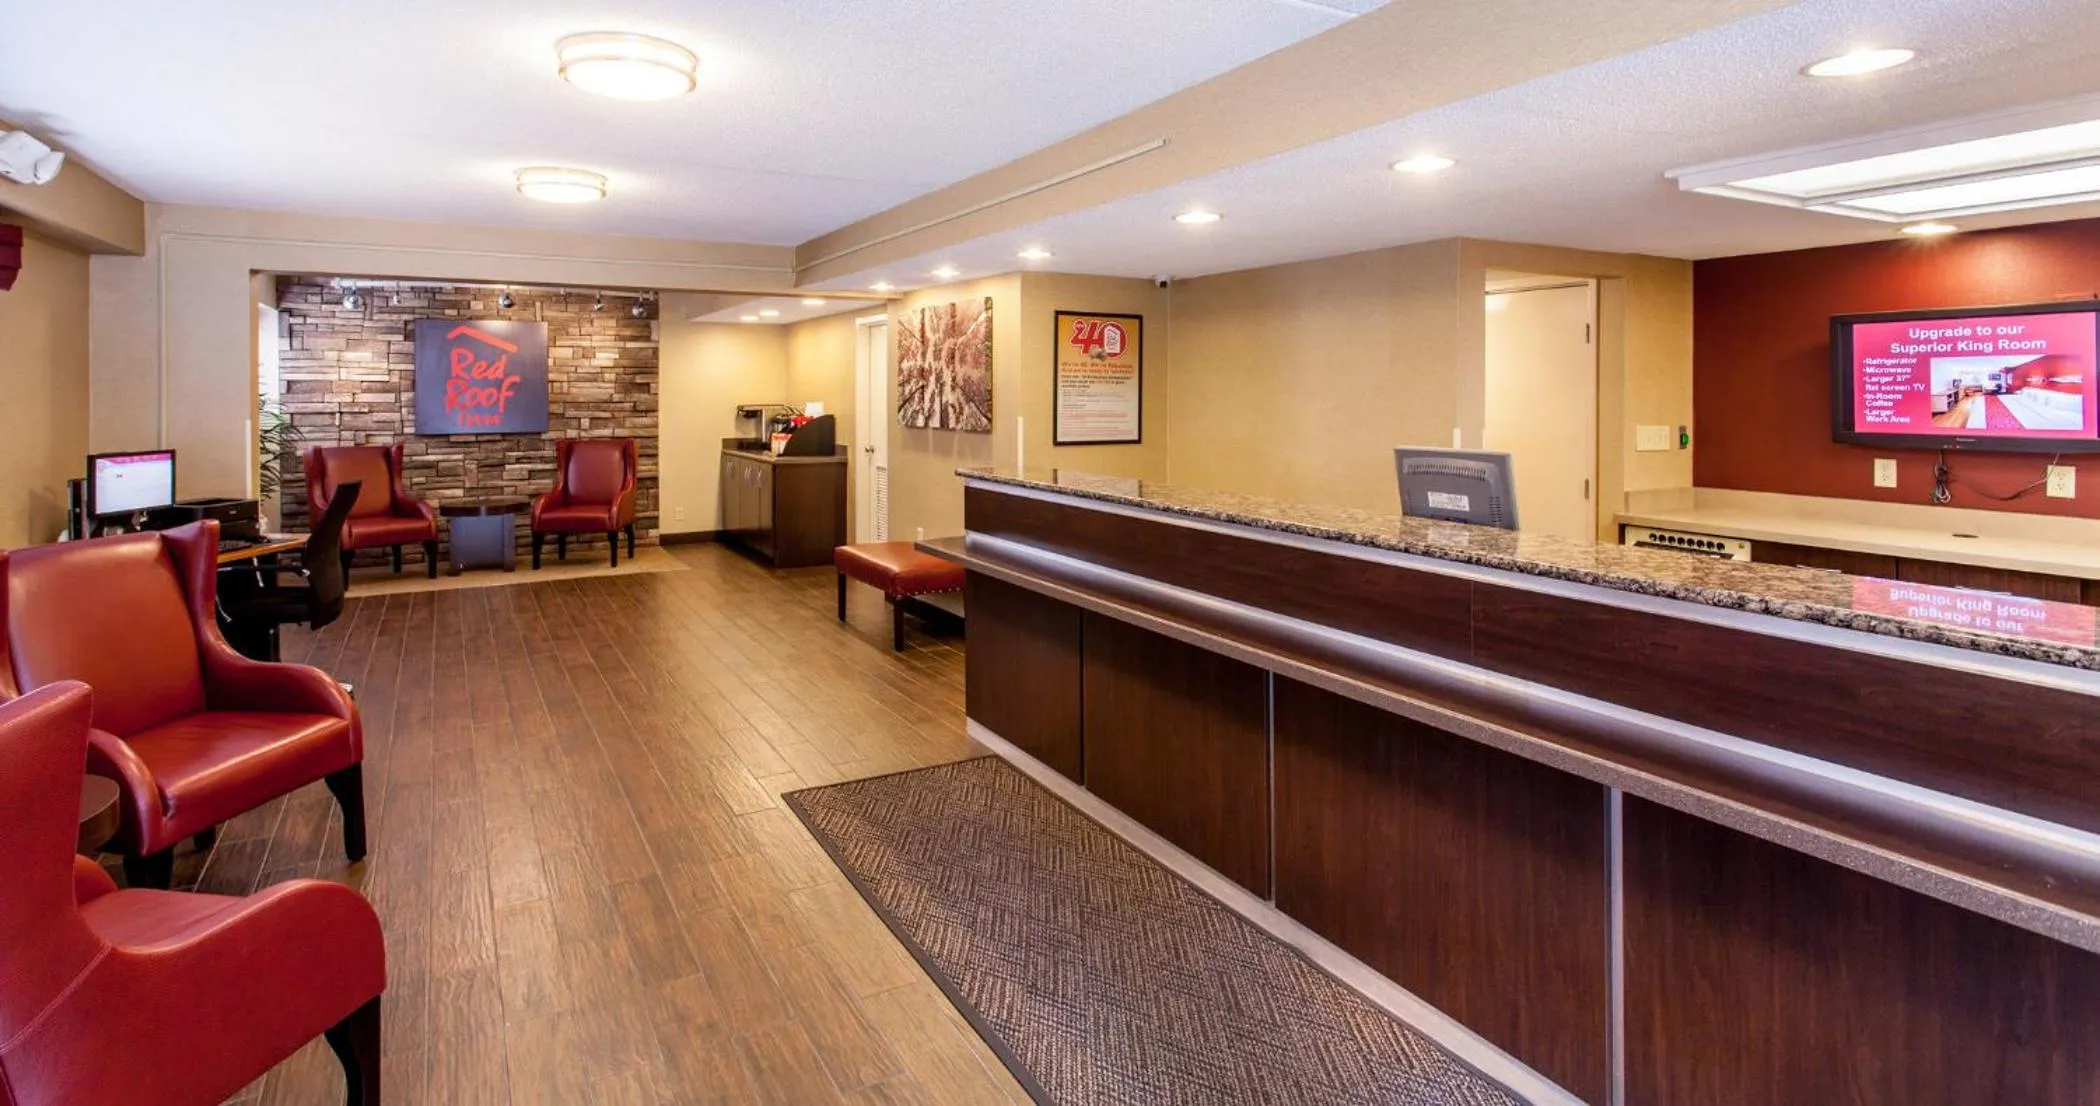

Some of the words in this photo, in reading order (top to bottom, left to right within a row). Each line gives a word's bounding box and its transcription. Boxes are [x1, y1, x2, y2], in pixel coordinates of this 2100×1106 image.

[1909, 326, 1972, 340] Upgrade
[1976, 326, 1992, 336] to
[1996, 325, 2025, 335] our
[1890, 342, 1953, 355] Superior
[1957, 341, 1993, 352] King
[1998, 339, 2047, 350] Room
[451, 347, 506, 380] Red
[446, 375, 520, 413] Roof
[1913, 383, 1925, 391] TV
